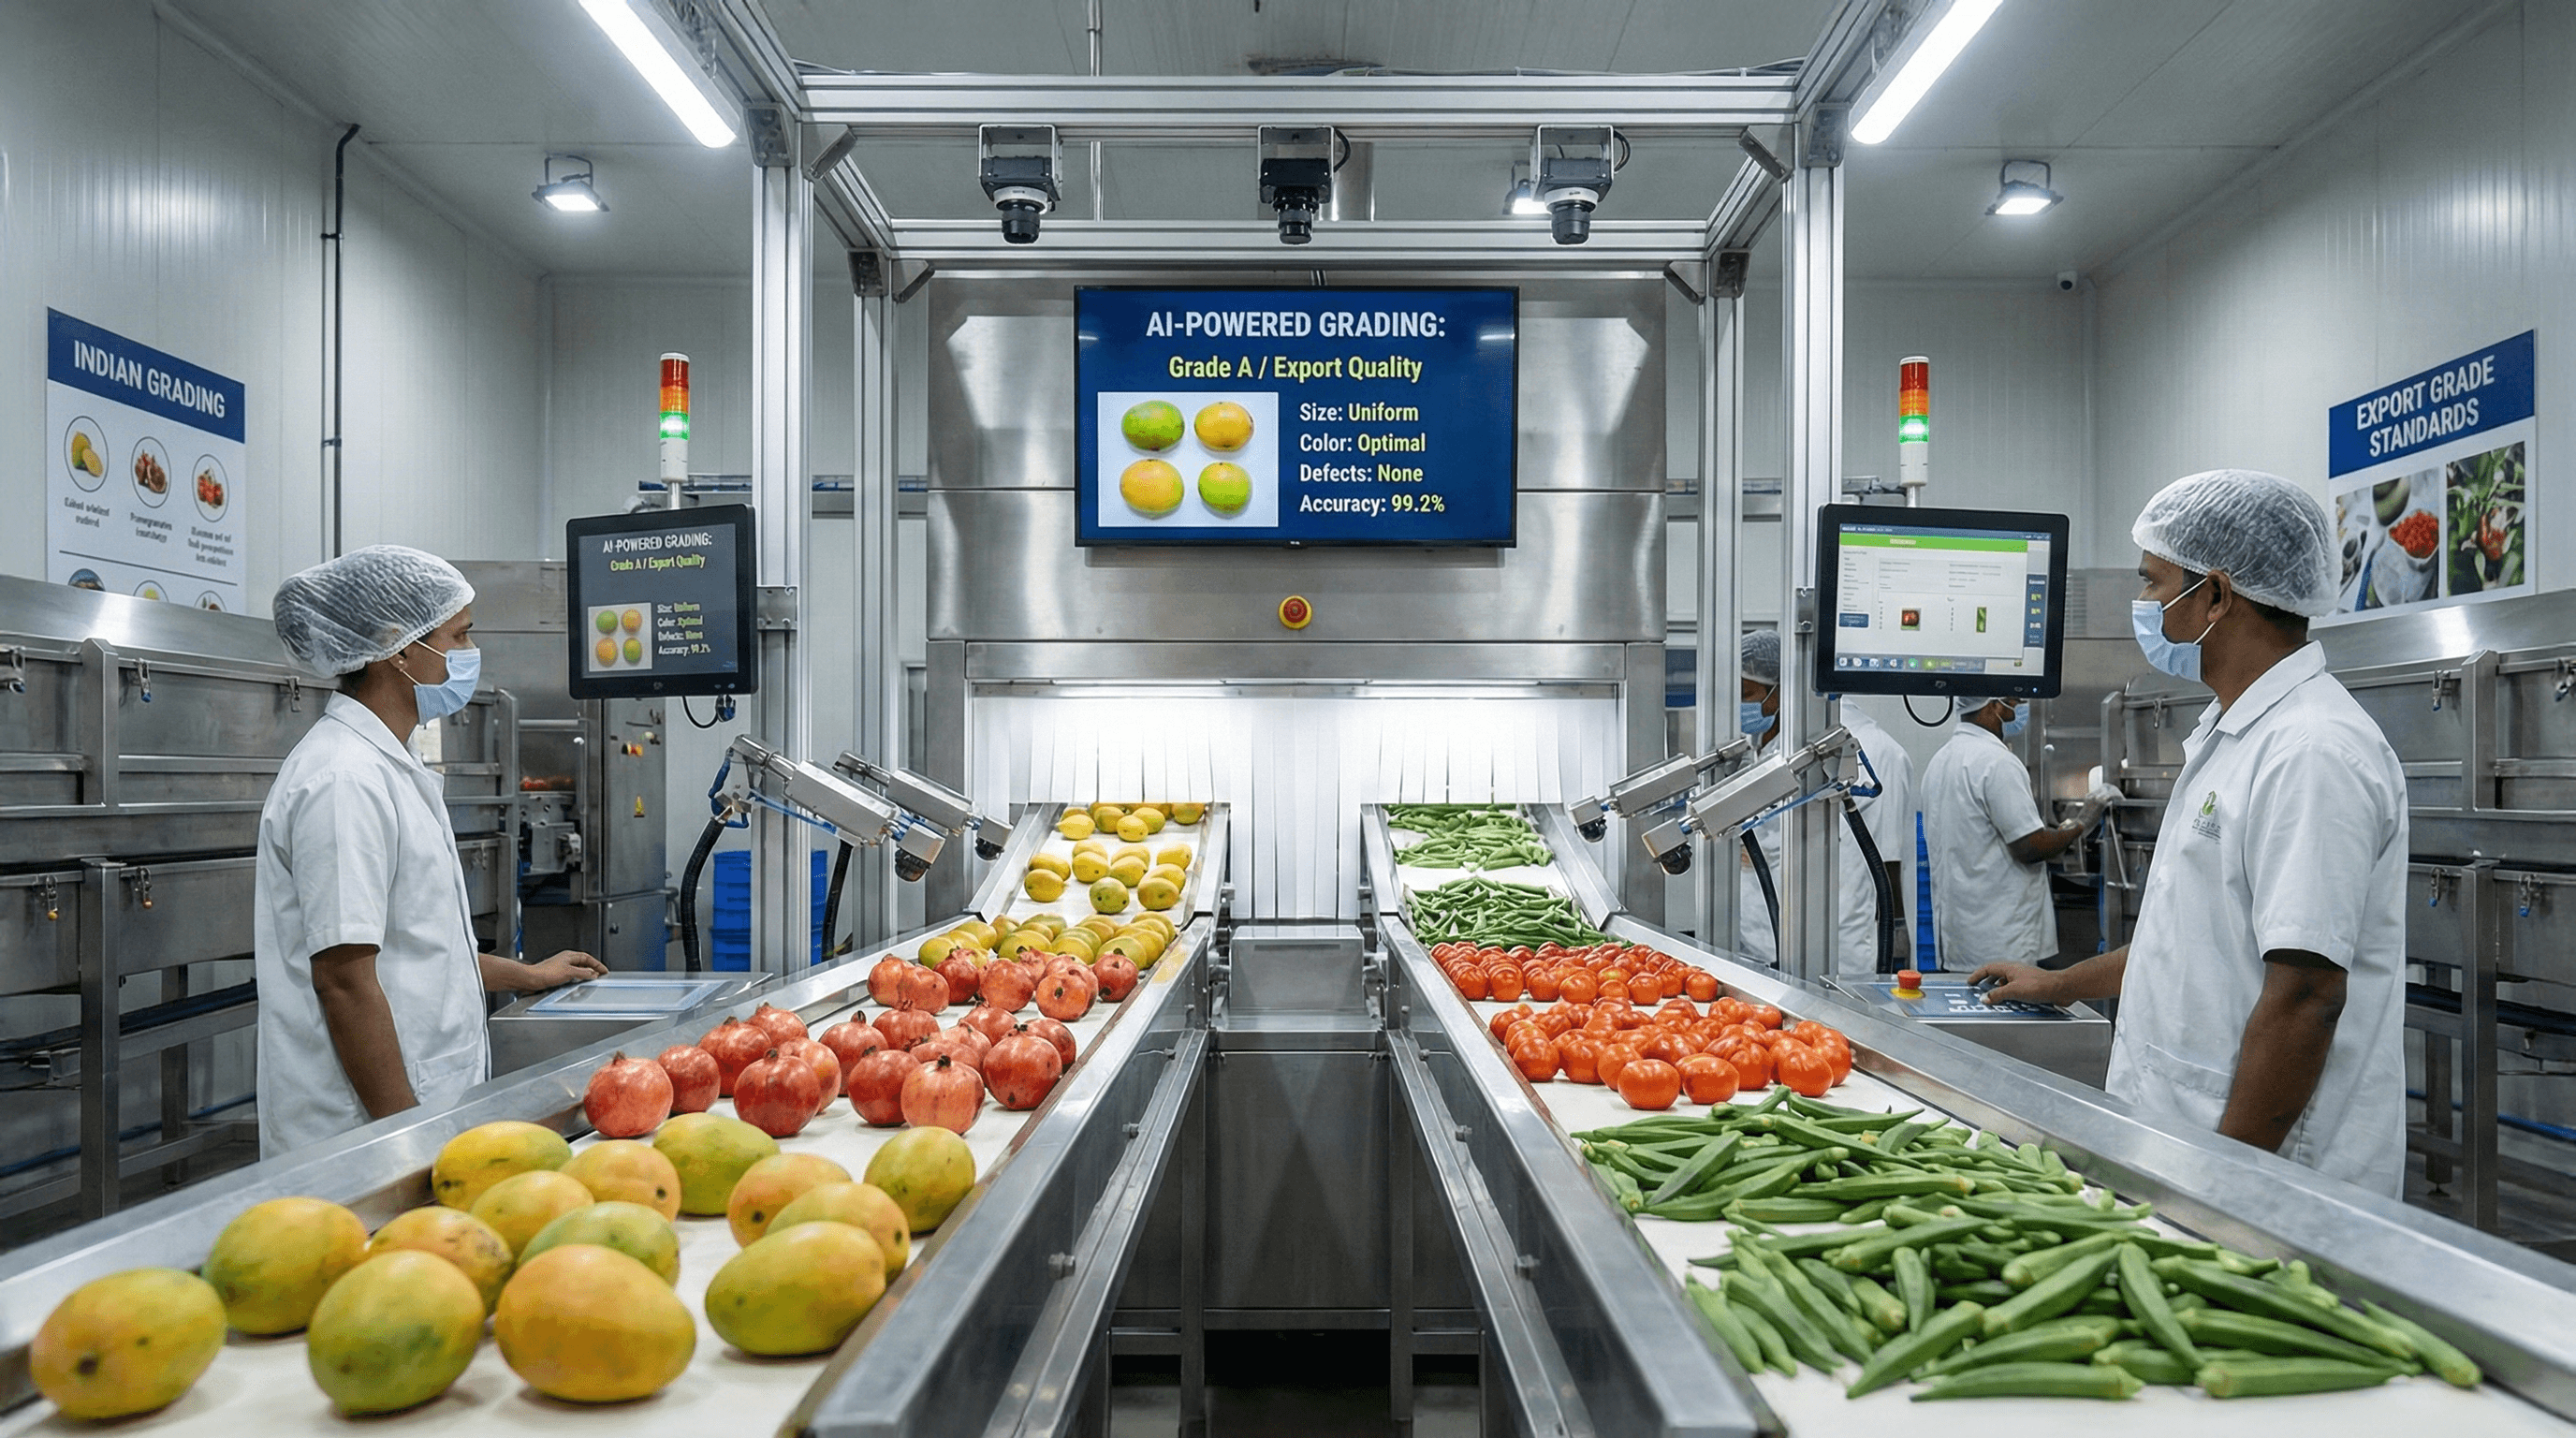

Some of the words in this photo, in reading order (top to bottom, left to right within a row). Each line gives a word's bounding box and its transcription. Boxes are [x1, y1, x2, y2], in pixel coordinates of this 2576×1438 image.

[1147, 312, 1310, 336] AI-POWERED
[1320, 312, 1444, 337] GRADING:
[74, 340, 142, 390] INDIAN
[147, 368, 225, 418] GRADING
[1170, 356, 1231, 377] Grade
[1237, 357, 1252, 377] A
[1258, 357, 1267, 379] /
[1275, 357, 1341, 383] Export
[1349, 356, 1422, 383] Quality
[2357, 380, 2426, 431] EXPORT
[2430, 355, 2495, 404] GRADE
[1300, 403, 1342, 421] Size:
[1349, 402, 1418, 420] Uniform
[2369, 397, 2479, 457] STANDARDS
[1300, 433, 1352, 451] Color:
[1358, 433, 1425, 456] Optimal
[1300, 463, 1371, 482] Defects:
[1379, 464, 1423, 481] None
[1300, 495, 1385, 517] Accuracy:
[1392, 494, 1444, 512] 99.2%
[603, 536, 662, 552] AI-POWERED
[665, 533, 711, 548] GRADING:
[635, 559, 641, 569] A
